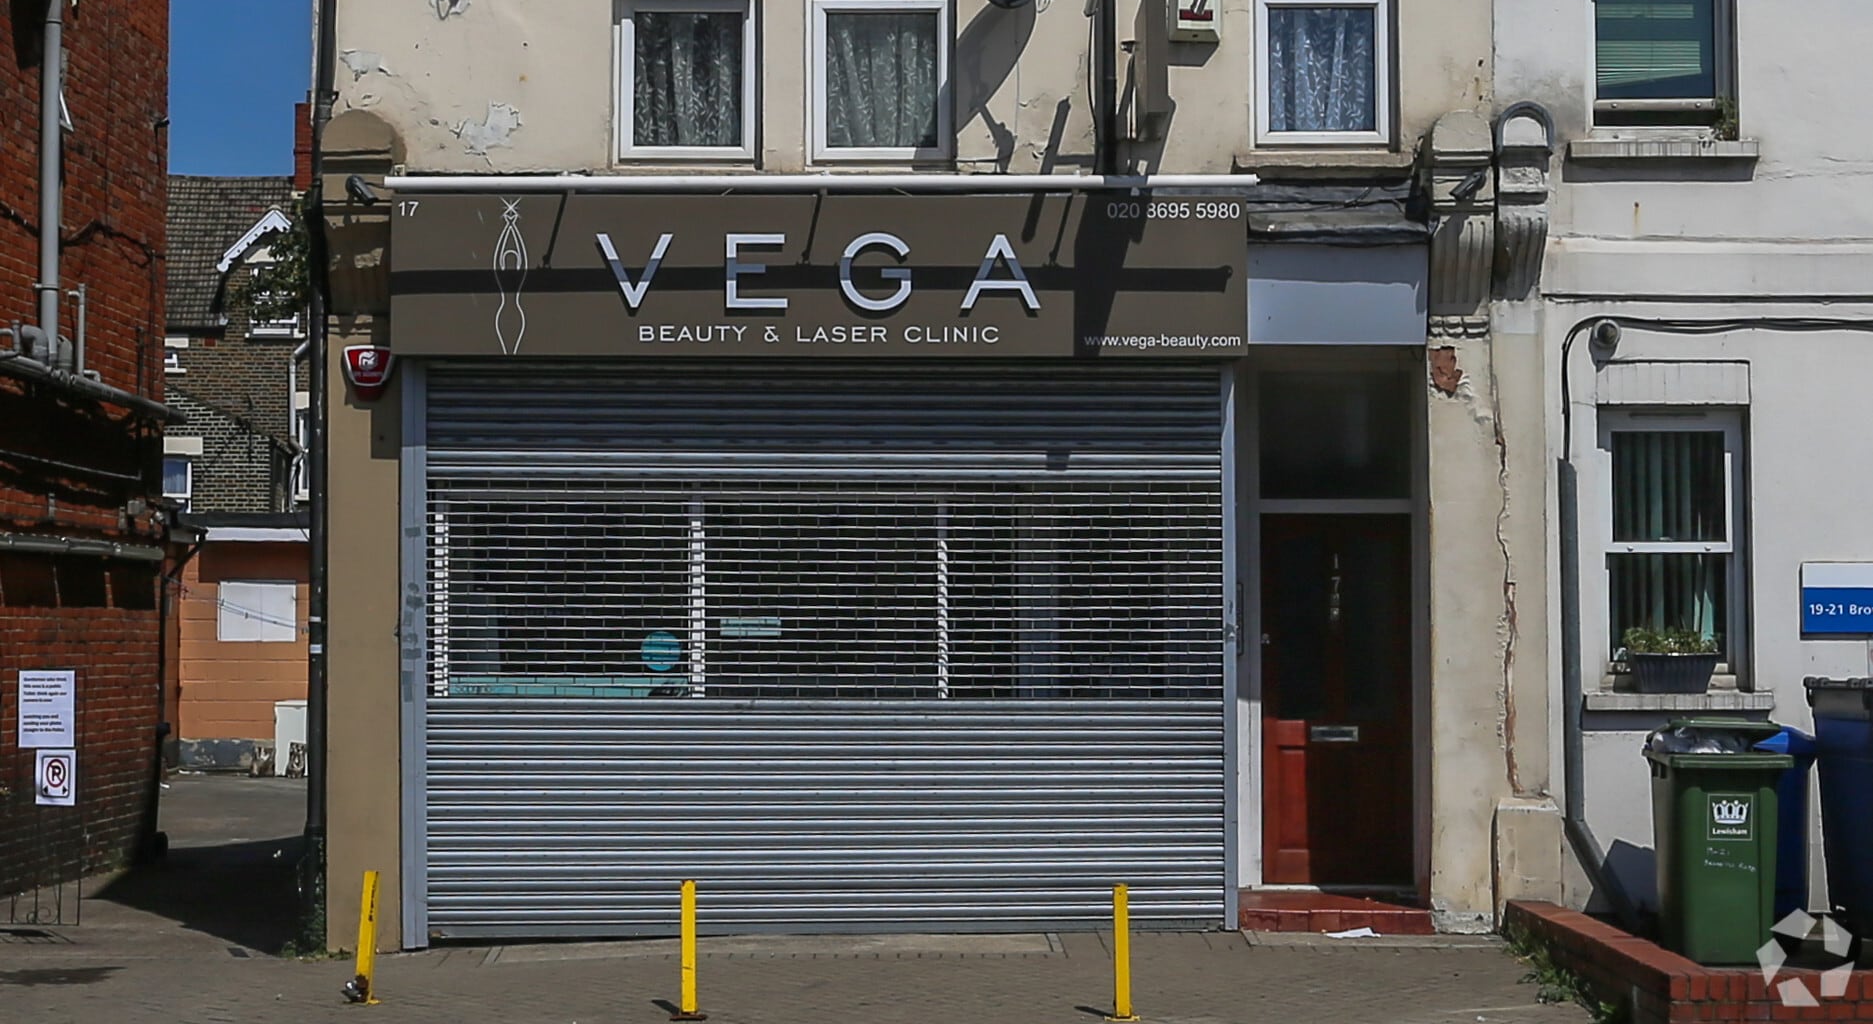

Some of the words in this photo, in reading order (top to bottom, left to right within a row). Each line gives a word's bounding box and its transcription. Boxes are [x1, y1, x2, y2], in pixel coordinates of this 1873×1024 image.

[397, 200, 419, 217] 17
[1107, 202, 1140, 219] 020
[1146, 202, 1190, 219] 8695
[1195, 202, 1240, 219] 5980
[596, 232, 1041, 312] VEGA
[639, 326, 747, 343] BEAUTY
[764, 326, 780, 343] &
[796, 326, 887, 343] LASER
[904, 326, 1000, 343] CLINIC
[1084, 333, 1241, 350] www.vega-beauty.com
[1809, 603, 1844, 616] 19-21
[1712, 827, 1748, 835] Lewisham
